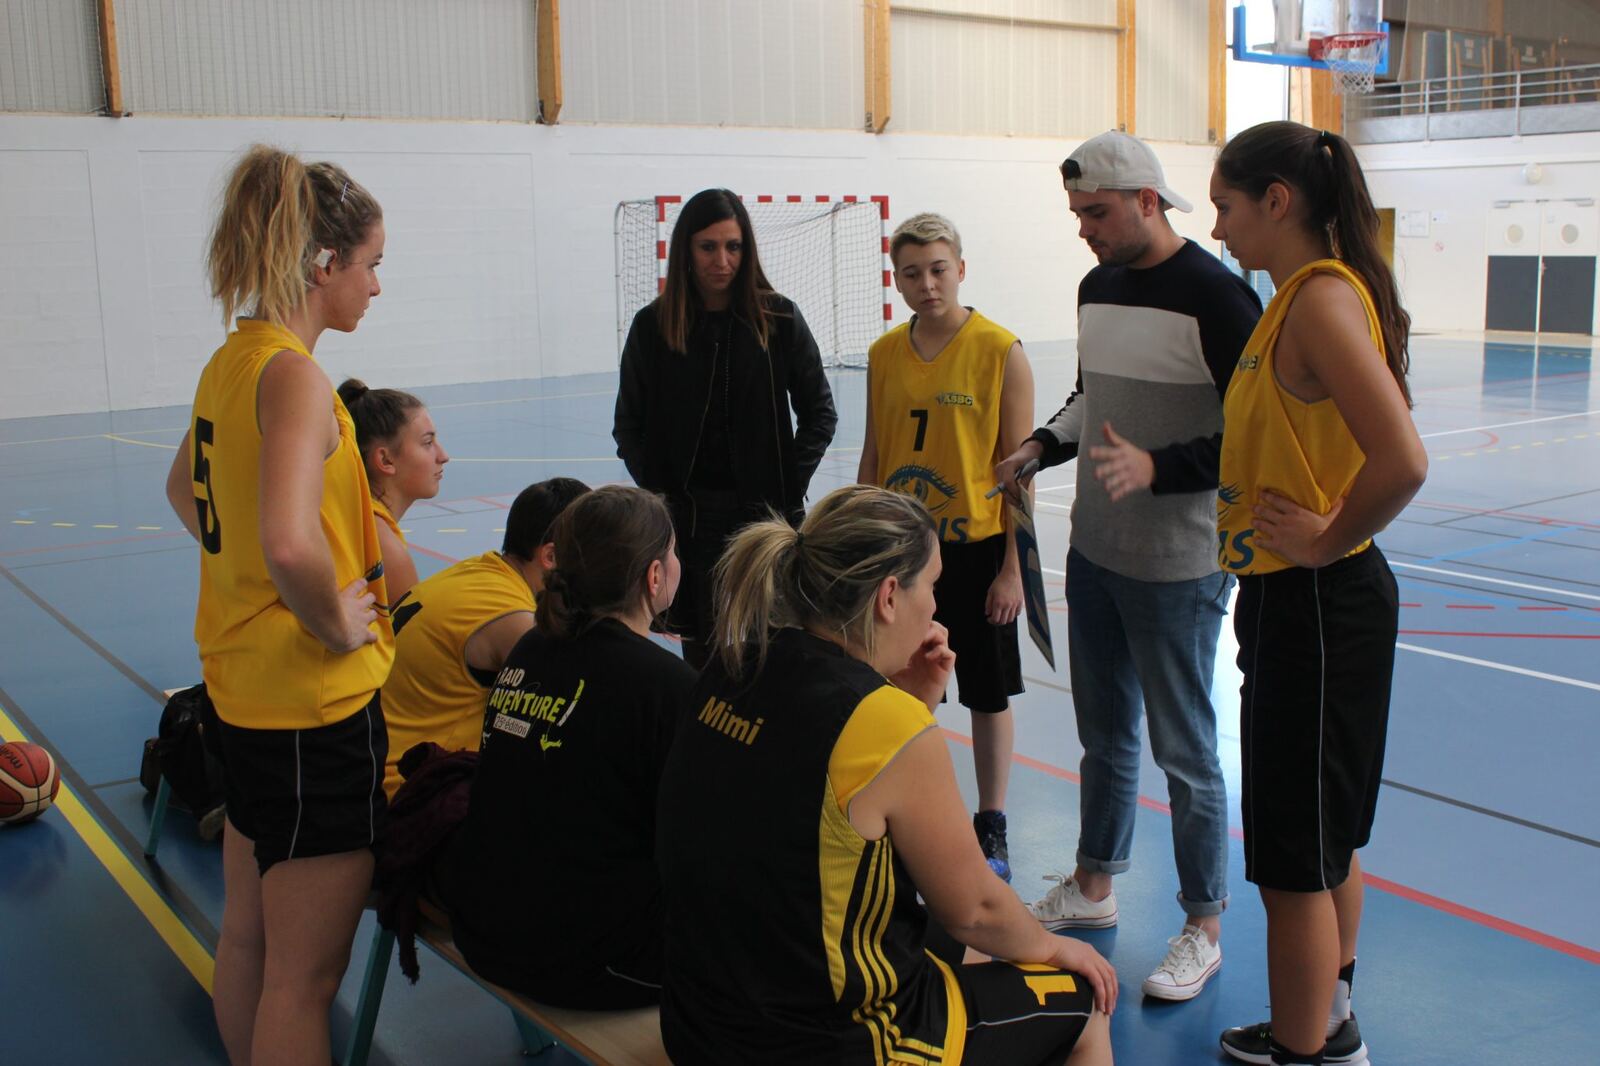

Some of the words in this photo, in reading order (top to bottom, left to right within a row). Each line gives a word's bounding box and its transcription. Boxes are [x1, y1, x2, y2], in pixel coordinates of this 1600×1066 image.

[911, 410, 928, 451] 7
[489, 688, 566, 723] AVENTURE
[698, 696, 764, 746] Mimi
[1016, 964, 1077, 1006] 1
